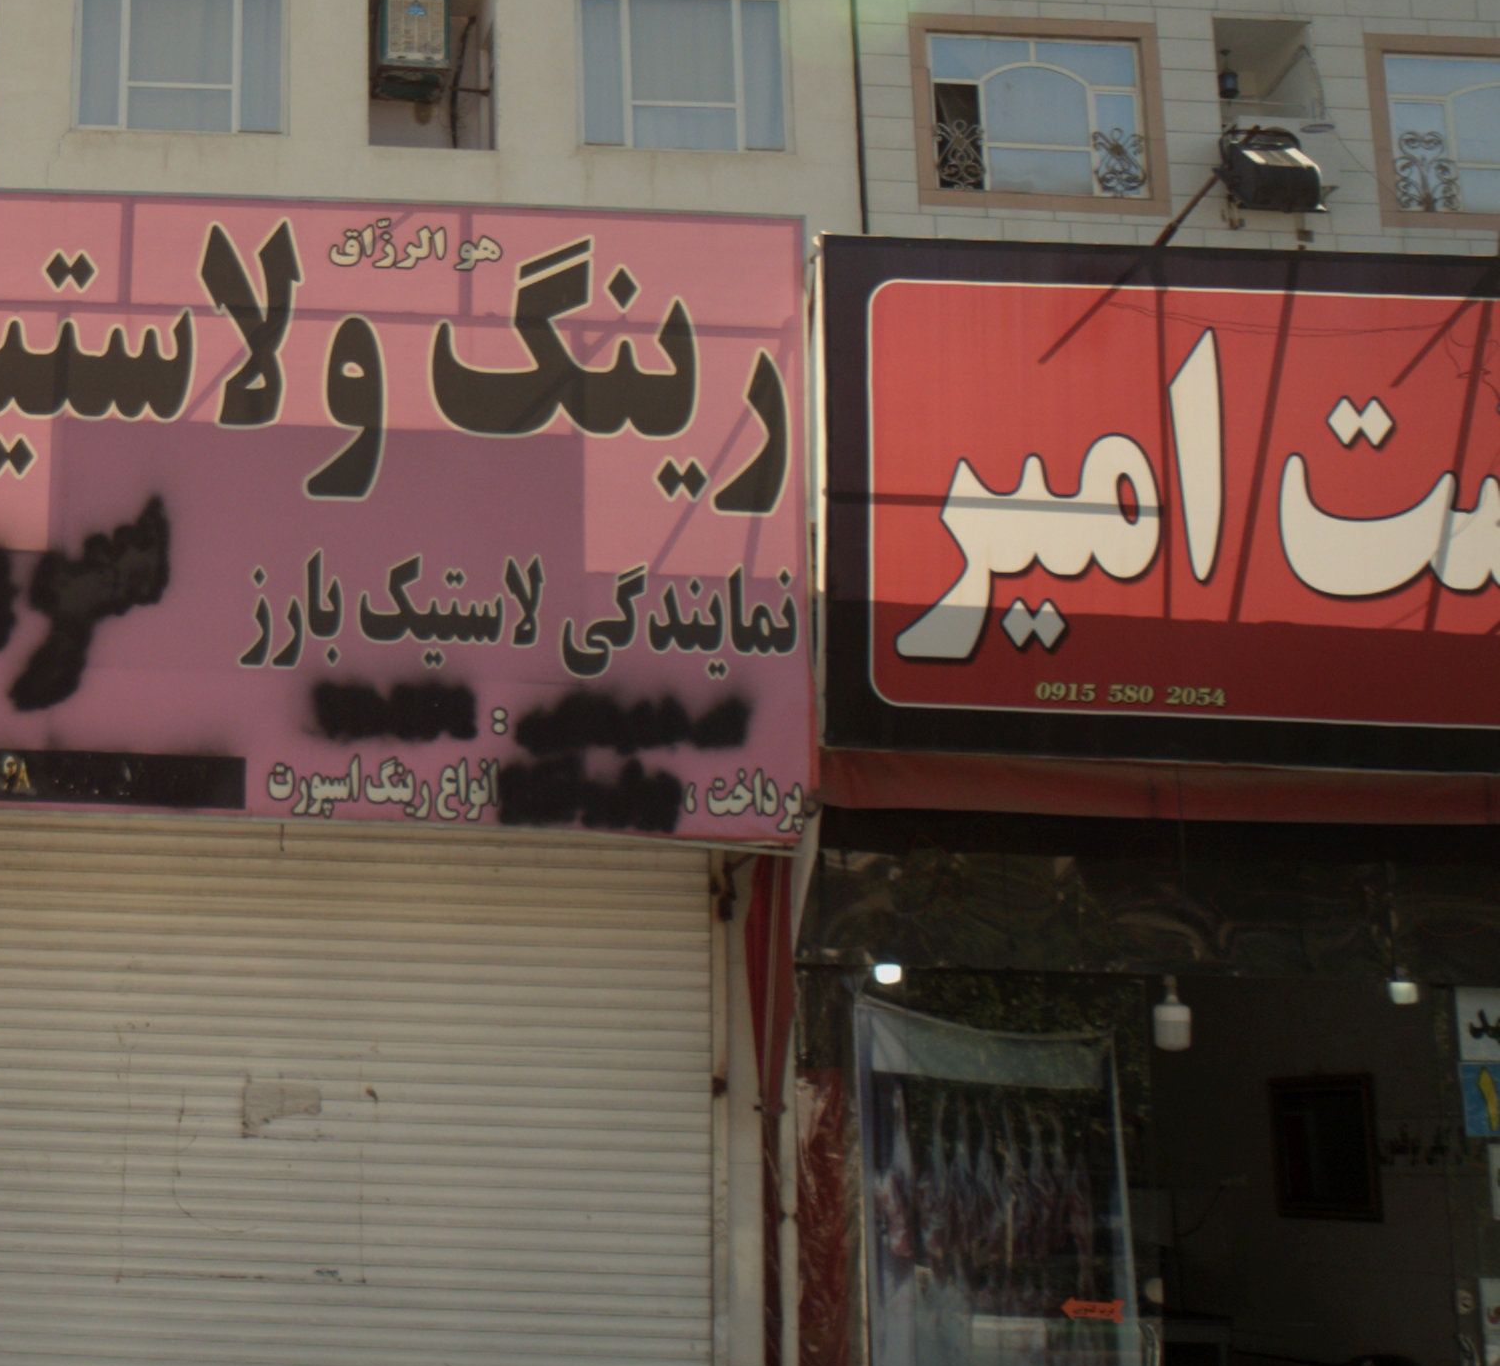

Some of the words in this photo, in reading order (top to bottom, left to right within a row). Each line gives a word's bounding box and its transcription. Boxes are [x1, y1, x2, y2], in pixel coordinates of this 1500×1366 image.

[454, 235, 503, 271] هو
[431, 236, 789, 515] رینگ
[895, 327, 1225, 665] امیر
[238, 548, 344, 669] بارز
[358, 553, 544, 669] لاستیک
[561, 562, 799, 678] نمایندگی
[1034, 681, 1097, 703] 0915
[1107, 684, 1154, 705] 580
[1165, 686, 1226, 708] 2054
[267, 753, 361, 818] اسپورت
[364, 756, 430, 818] رینگ
[436, 757, 500, 820] انواع
[707, 767, 805, 834] پرداخت
